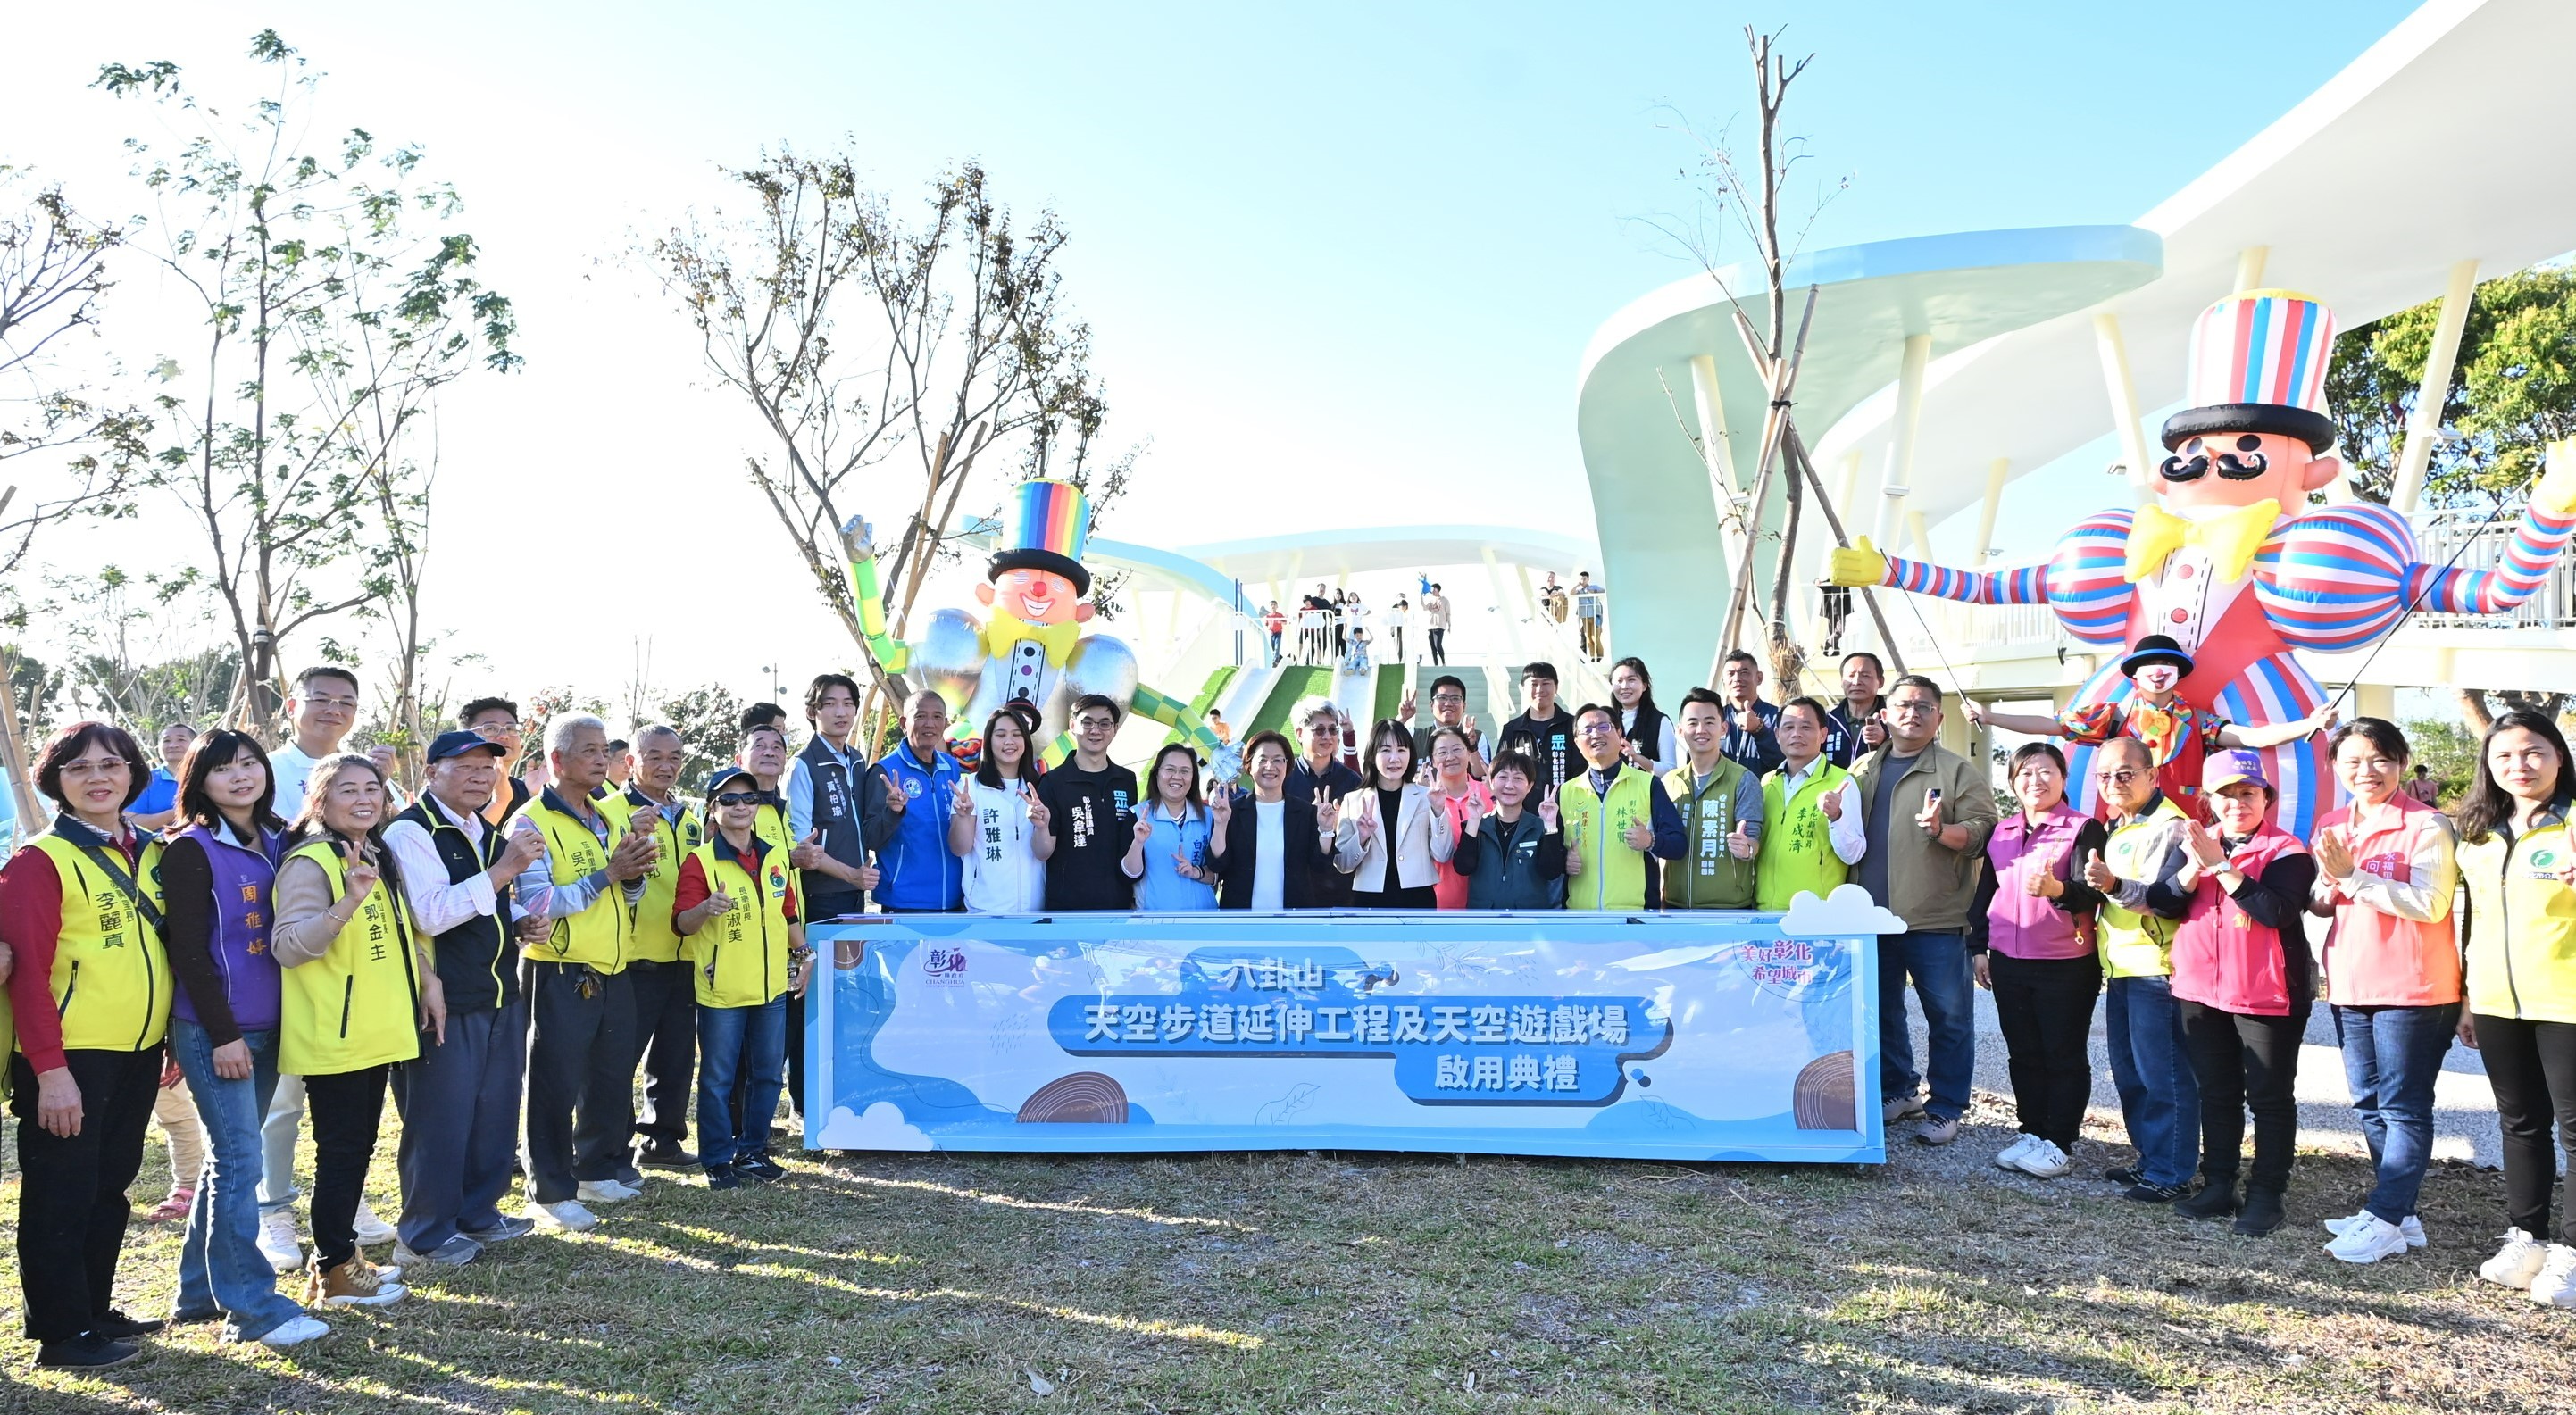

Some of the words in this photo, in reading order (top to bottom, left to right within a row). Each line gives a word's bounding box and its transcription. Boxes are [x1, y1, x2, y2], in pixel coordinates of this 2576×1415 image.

[982, 808, 1002, 862] 許雅琳
[1071, 806, 1088, 848] 吳韋達
[1616, 807, 1628, 844] 林世賢
[1700, 799, 1719, 859] 陳素月
[1788, 807, 1807, 854] 李成濟
[95, 892, 125, 949] 李麗真
[363, 903, 386, 961] 郭金主
[727, 897, 742, 943] 黃淑美
[1741, 939, 1812, 963] 美好彰化
[1225, 956, 1324, 990] 八卦山
[1752, 965, 1813, 985] 希望城市
[1083, 1003, 1628, 1045] 天空步道延伸工程及天空遊戲場
[1434, 1053, 1580, 1091] 啟用典禮
